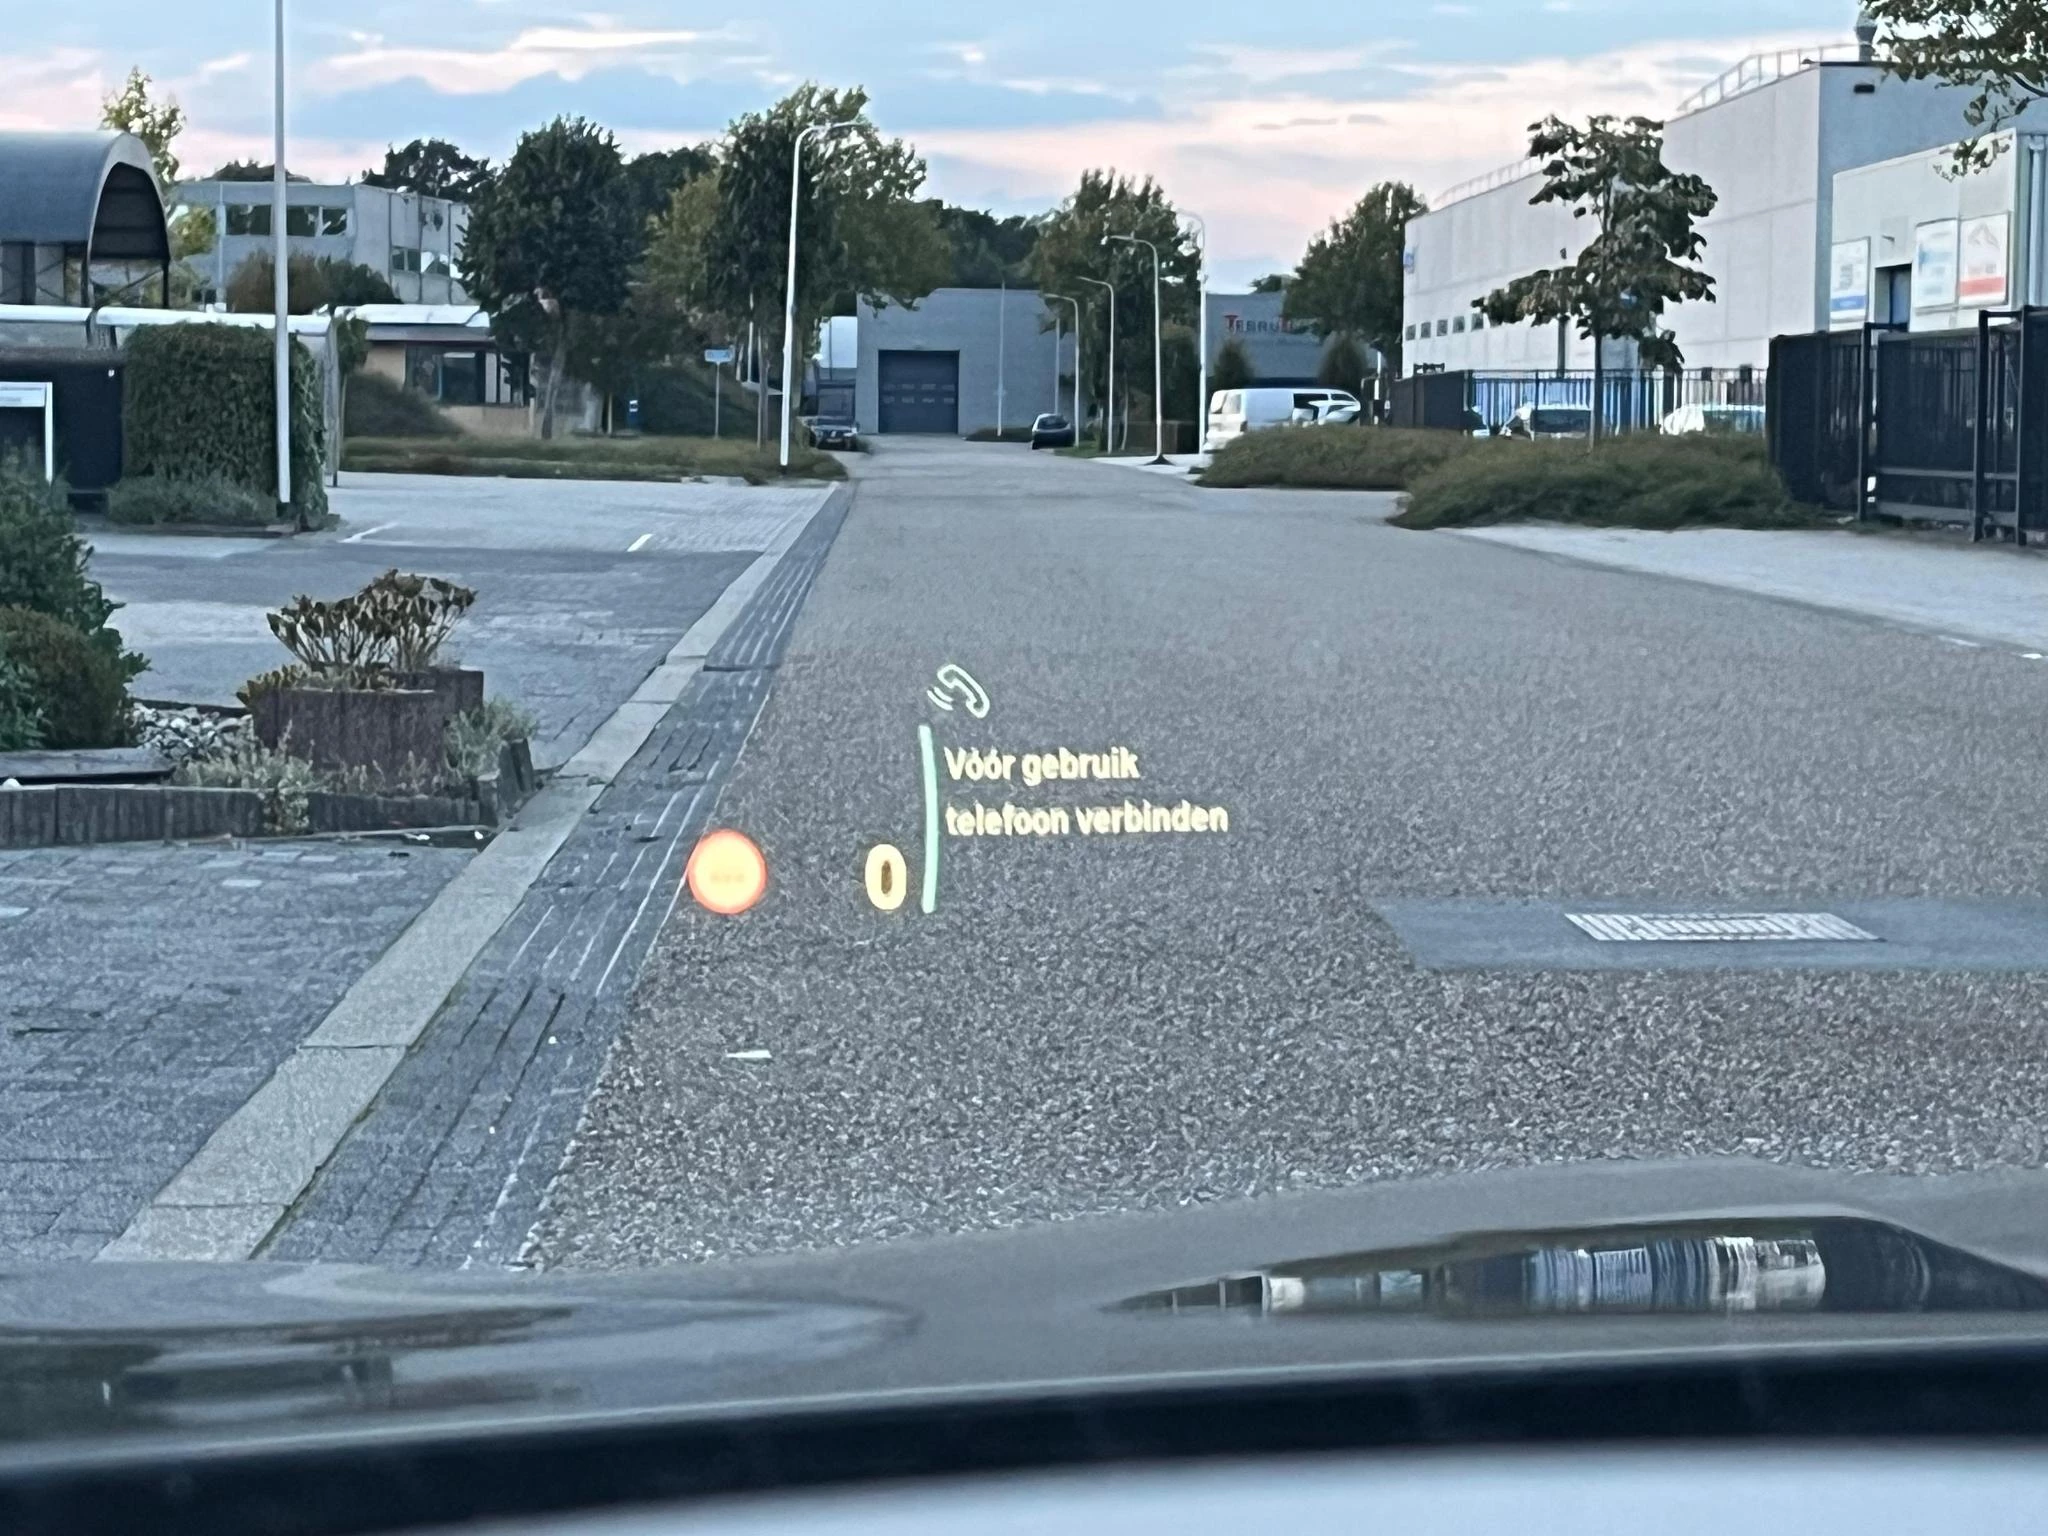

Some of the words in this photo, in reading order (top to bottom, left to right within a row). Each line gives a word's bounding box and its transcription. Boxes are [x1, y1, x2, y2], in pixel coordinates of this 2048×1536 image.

[1021, 746, 1141, 787] gebruik
[945, 799, 1070, 836] telefoon
[1075, 799, 1229, 835] verbinden
[865, 843, 907, 911] 0
